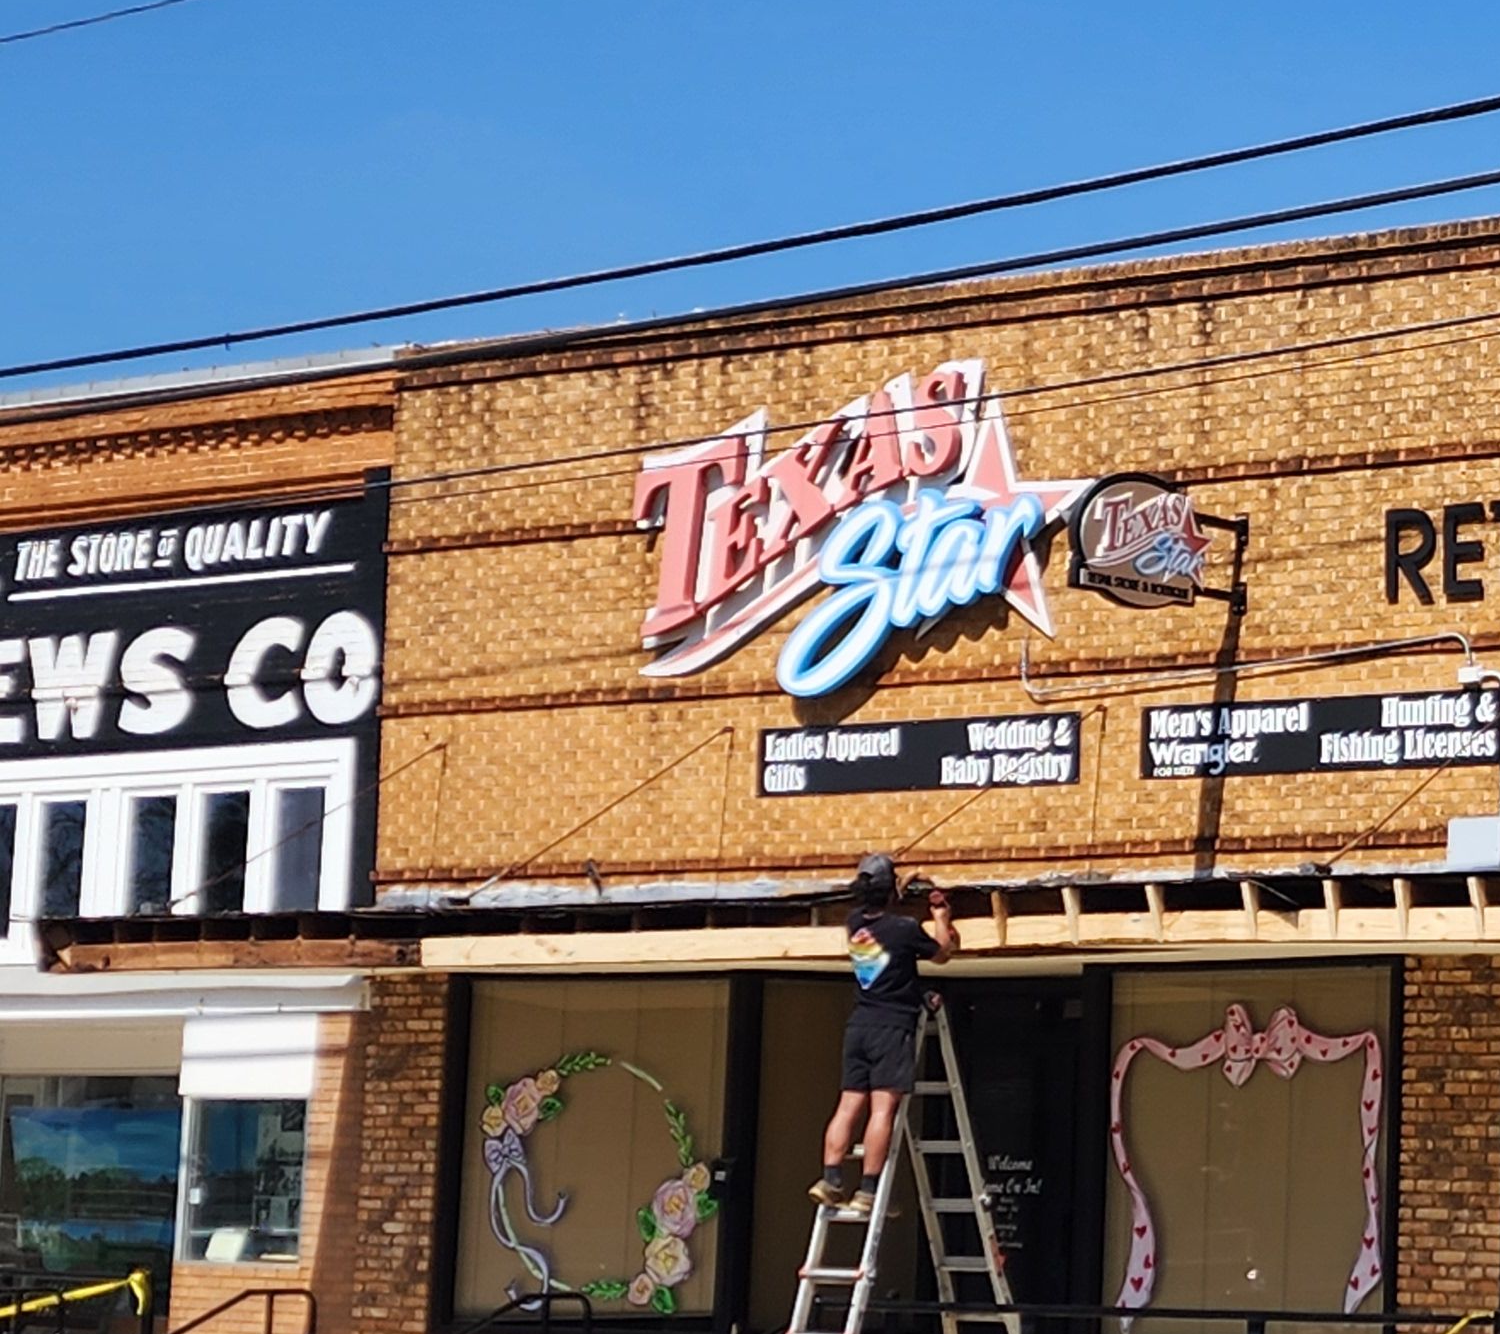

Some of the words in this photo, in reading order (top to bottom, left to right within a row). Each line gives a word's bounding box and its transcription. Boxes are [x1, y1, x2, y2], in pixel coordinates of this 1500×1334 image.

[633, 359, 984, 648] TEXAS
[1095, 493, 1184, 557] TEXAS
[14, 538, 61, 582] THE
[67, 528, 153, 577] STORE
[155, 531, 179, 567] OF
[184, 509, 334, 572] QUALITY
[1133, 532, 1204, 577] Star
[776, 491, 1042, 697] Star
[224, 610, 378, 730] CO
[1149, 709, 1213, 739] Men's
[1217, 701, 1311, 738] Apparel
[1381, 693, 1471, 727] Hunting
[1475, 692, 1496, 723] &
[764, 732, 823, 762] Ladies
[825, 727, 900, 762] Apparel
[966, 720, 1050, 752] Wedding
[1053, 717, 1072, 746] &
[1320, 728, 1401, 765] Fishing
[1403, 727, 1496, 761] Licenses
[763, 765, 808, 793] Gifts
[940, 756, 990, 786] Baby
[992, 751, 1073, 784] Registry
[988, 1154, 1033, 1171] Welcome
